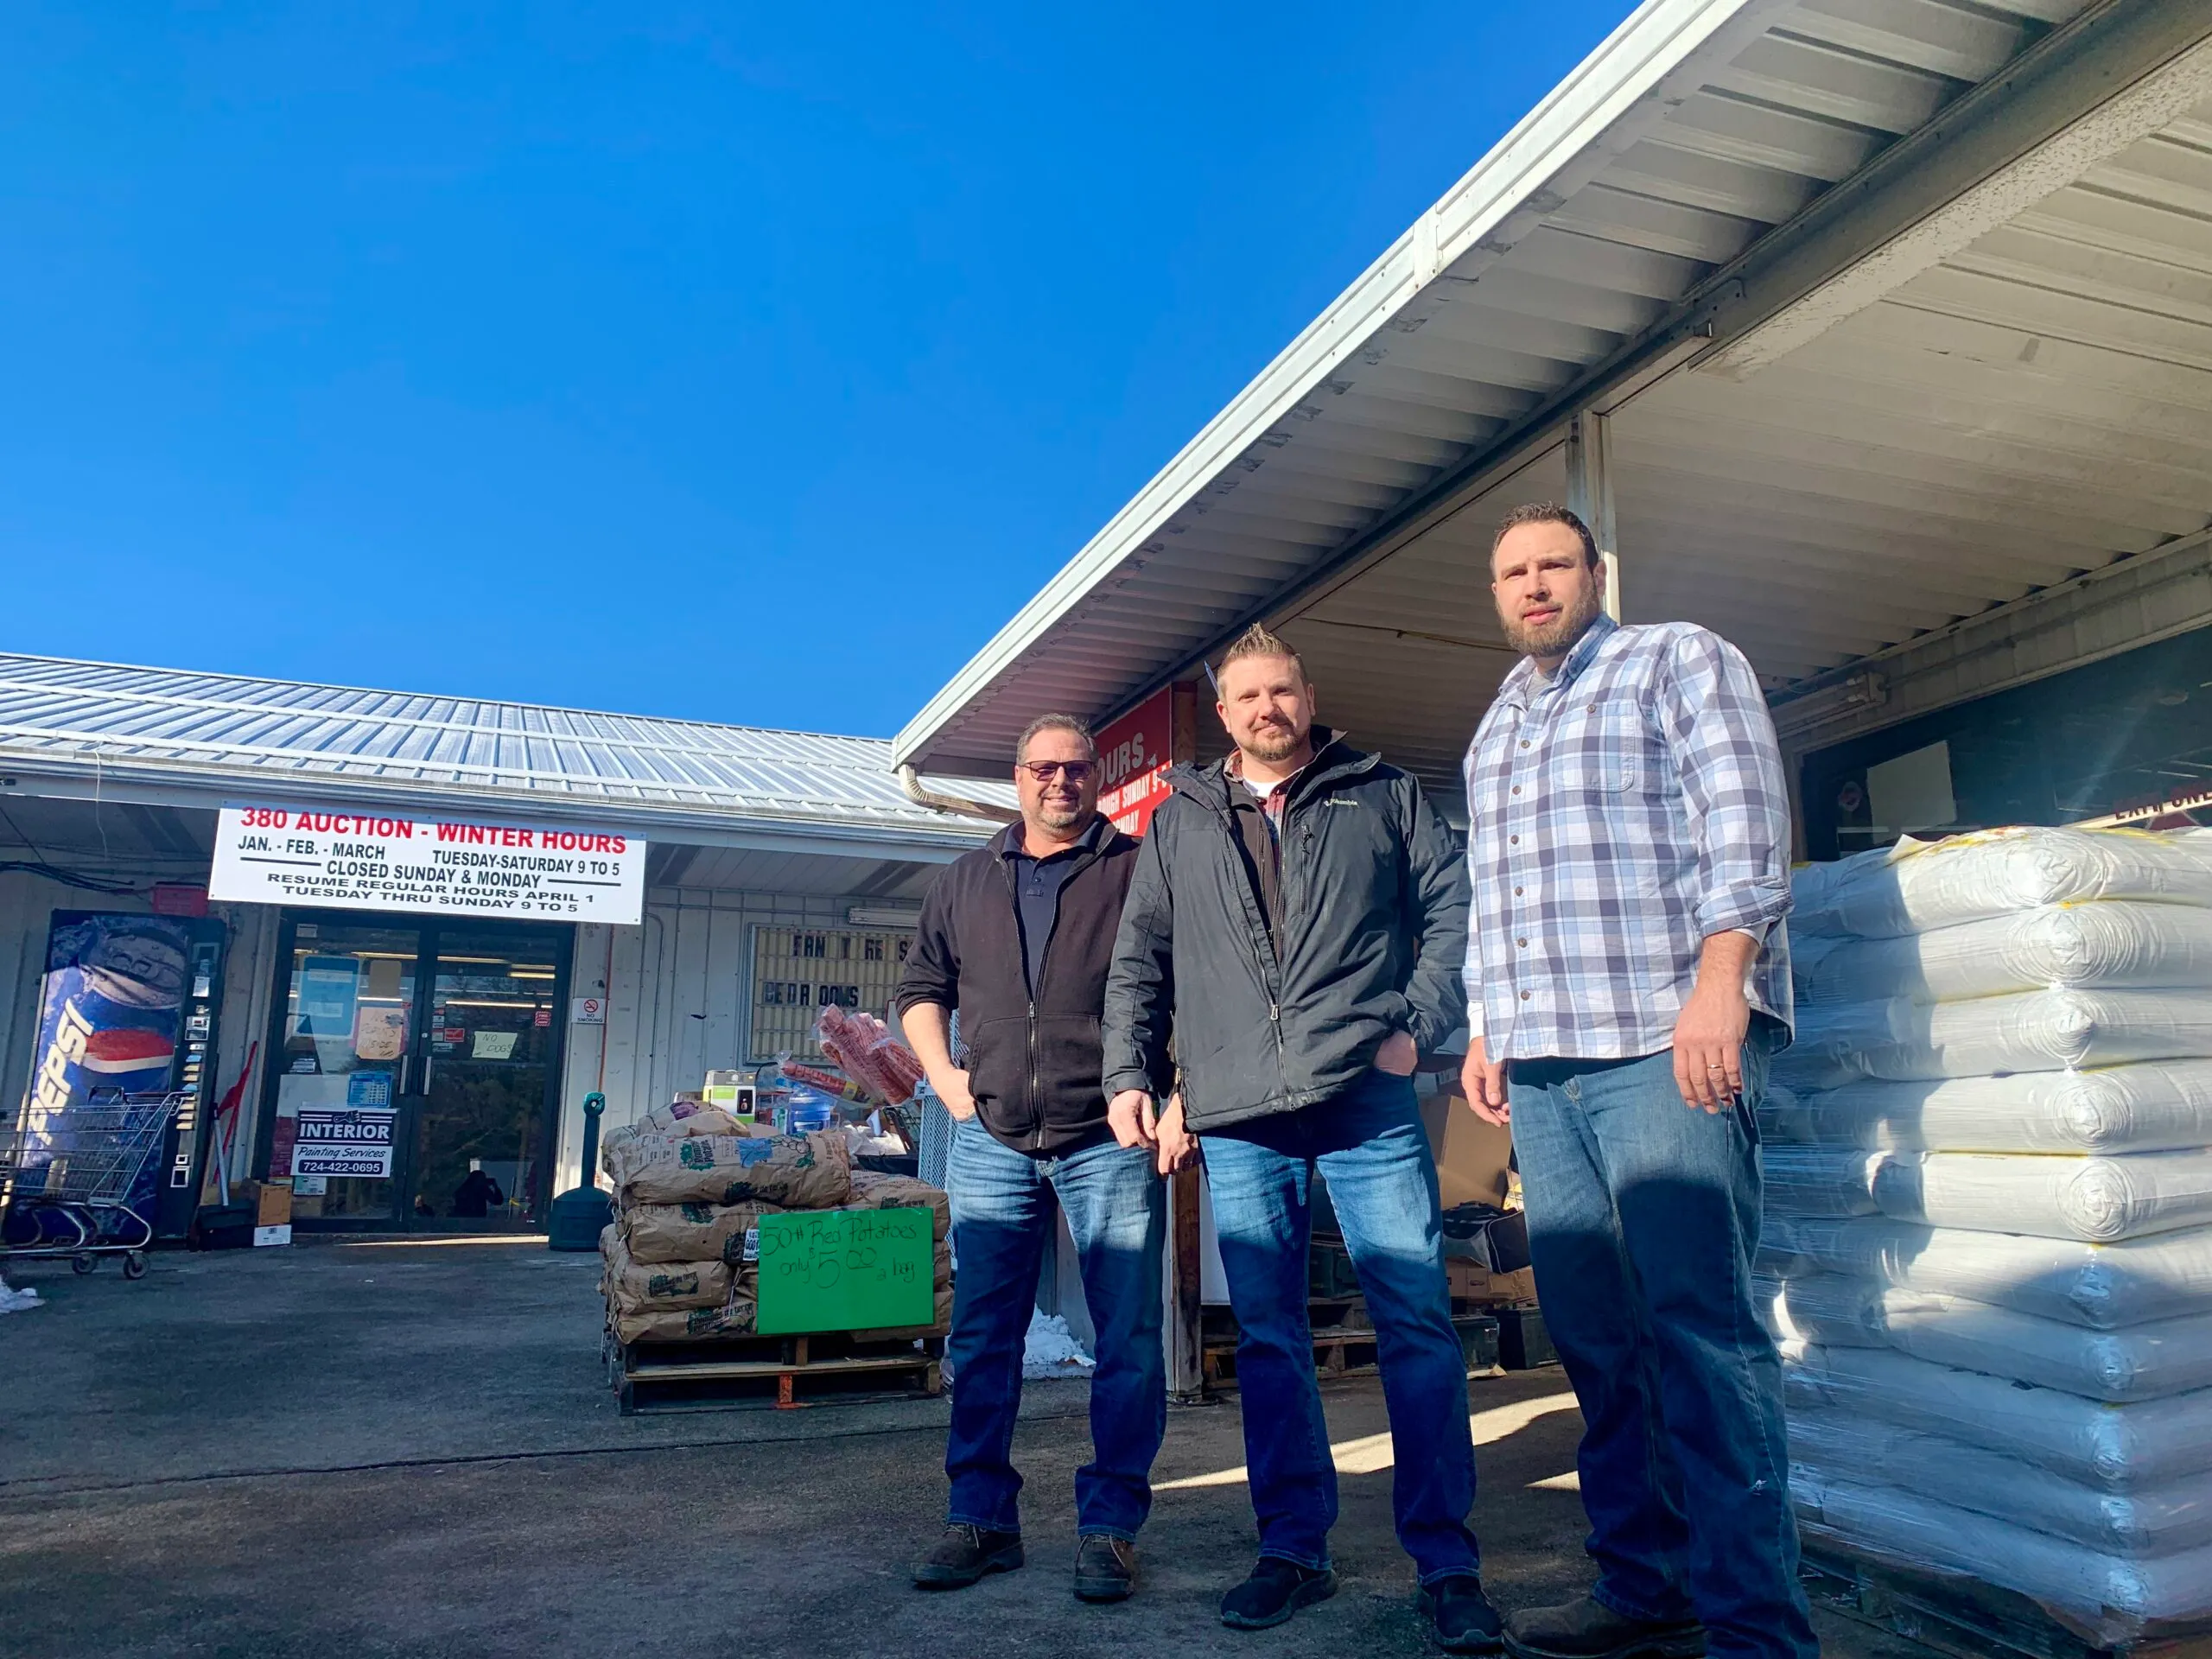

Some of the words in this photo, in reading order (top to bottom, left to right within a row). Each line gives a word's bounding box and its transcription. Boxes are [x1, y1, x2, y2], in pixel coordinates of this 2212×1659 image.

[1097, 733, 1144, 791] OURS
[1122, 773, 1150, 809] SUNDAY
[240, 806, 288, 829] 380
[295, 811, 413, 839] AUCTION
[436, 823, 533, 848] WINTER
[542, 830, 626, 854] HOURS
[238, 835, 272, 851] JAN.
[286, 839, 318, 855] FEB.
[332, 842, 385, 860] MARCH
[327, 860, 389, 878] CLOSED
[393, 865, 456, 883] SUNDAY
[461, 869, 472, 884] &
[477, 870, 542, 888] MONDAY
[432, 850, 574, 873] TUESDAY-SATURDAY
[578, 861, 586, 874] 9
[590, 861, 607, 874] TO
[612, 862, 620, 876] 5
[267, 874, 350, 887] RESUME
[356, 880, 447, 893] REGULAR
[454, 887, 519, 898] HOURS
[524, 891, 579, 902] APRIL
[283, 886, 373, 899] TUESDAY
[379, 892, 432, 904] THRU
[439, 896, 514, 909] SUNDAY
[521, 901, 531, 910] 9
[537, 902, 561, 912] TO
[568, 904, 578, 912] 5
[486, 1044, 512, 1053] DOGS
[29, 997, 95, 1147] PEPSI
[299, 1123, 390, 1139] INTERIOR
[297, 1147, 340, 1160] Painting
[342, 1147, 386, 1158] Services
[303, 1162, 380, 1173] 724-422-0695
[763, 1224, 804, 1256] 50#
[807, 1220, 842, 1245] Red
[840, 1217, 917, 1243] Potatoes
[780, 1258, 811, 1284] only
[893, 1257, 916, 1283] bag
